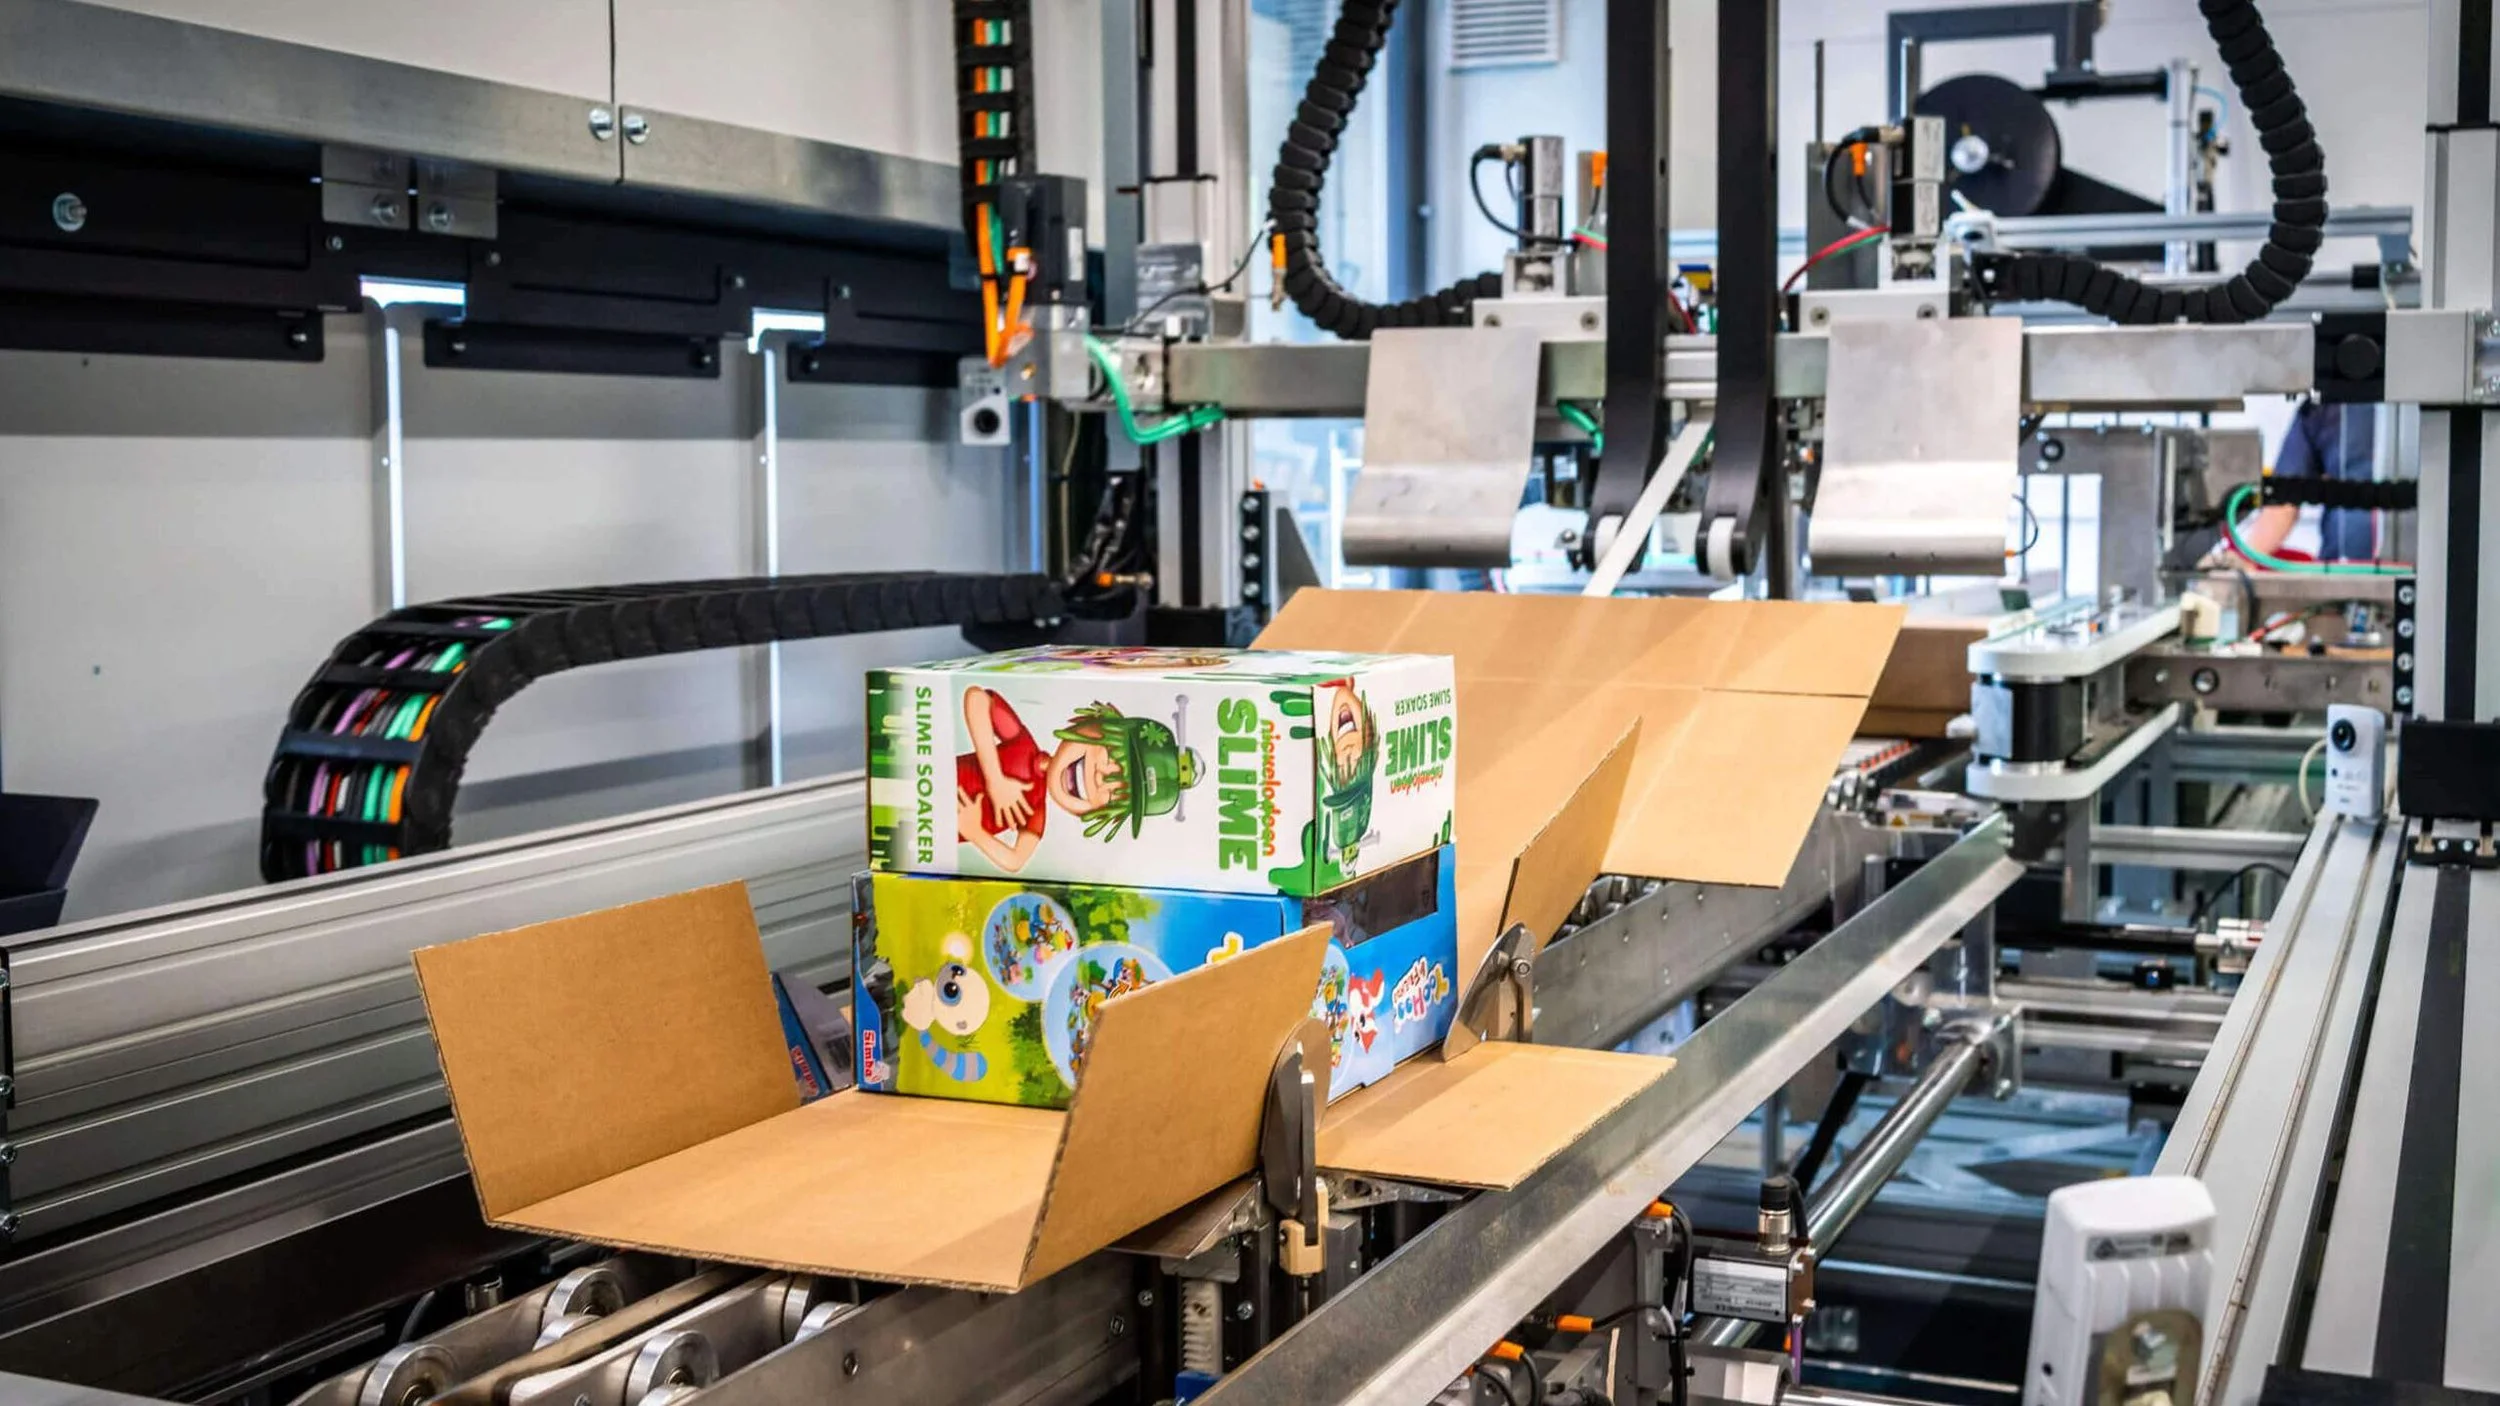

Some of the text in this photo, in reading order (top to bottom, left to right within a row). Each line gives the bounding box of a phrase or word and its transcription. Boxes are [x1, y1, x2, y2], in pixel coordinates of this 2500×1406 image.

[1385, 716, 1452, 776] SLIME
[1394, 689, 1451, 716] SLIME SOAKER
[915, 686, 933, 864] SLIME SOAKER
[1217, 697, 1258, 871] SLIME
[1261, 719, 1281, 856] nickelodeon
[864, 1030, 876, 1078] Simba
